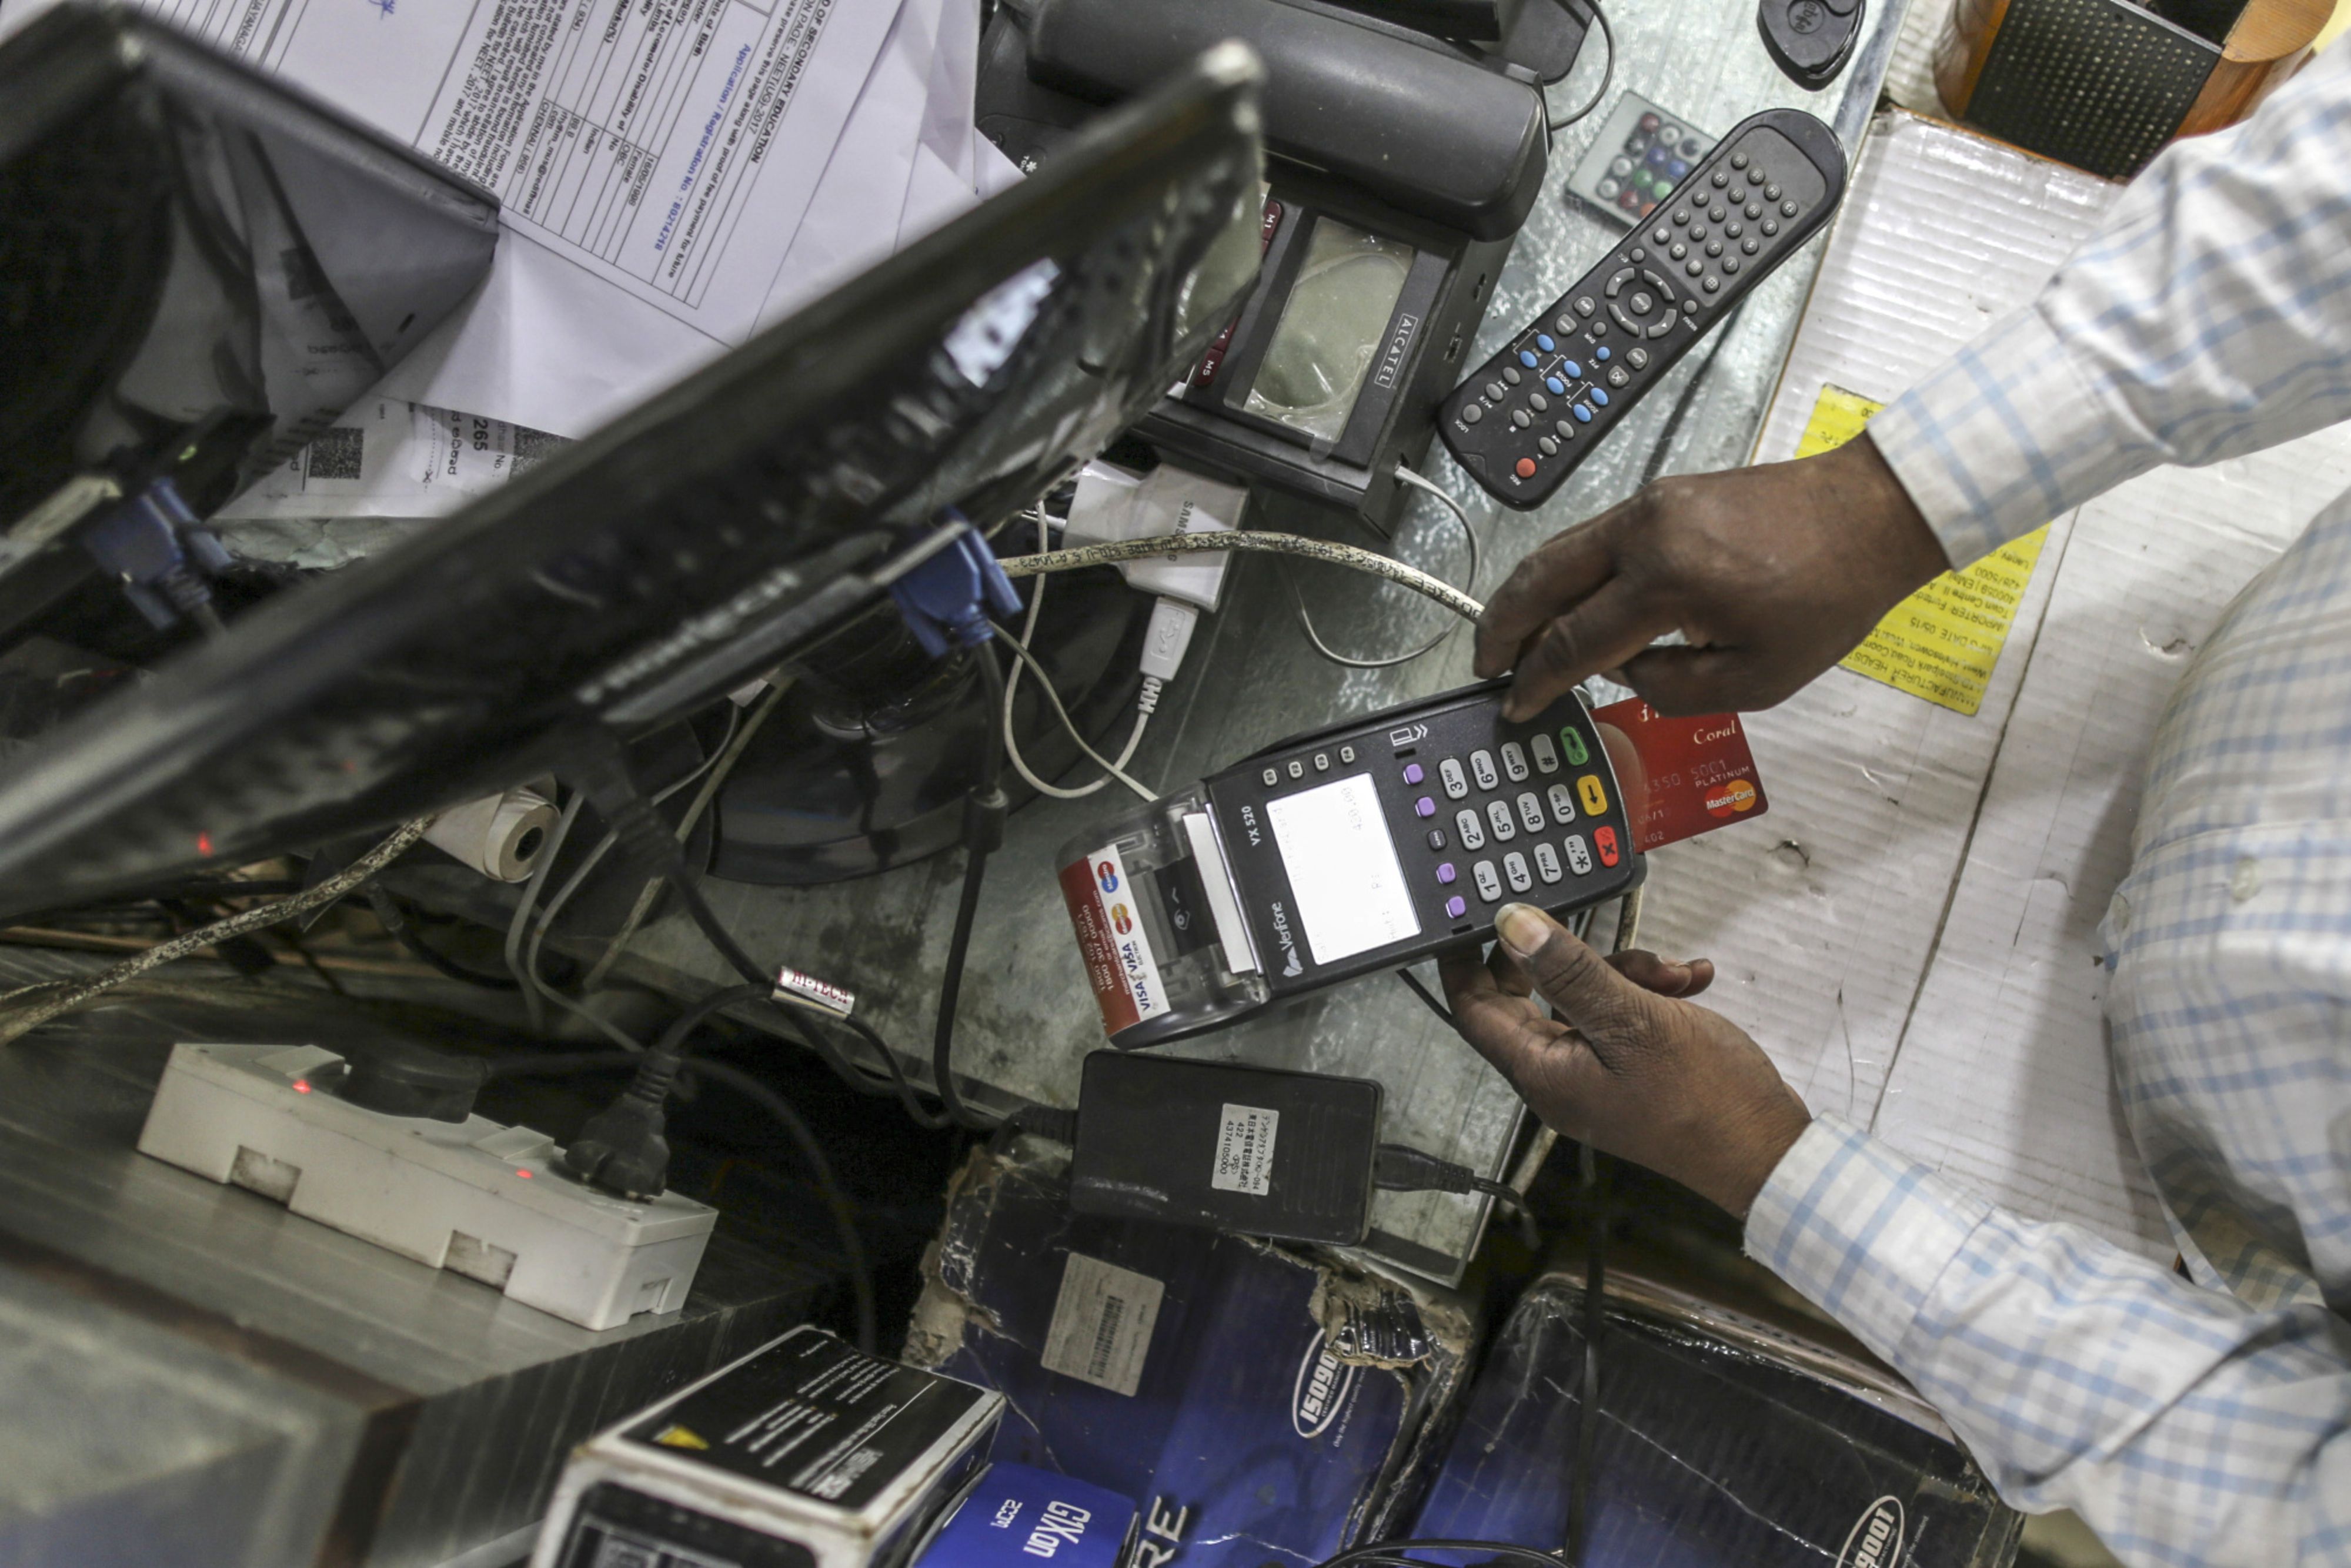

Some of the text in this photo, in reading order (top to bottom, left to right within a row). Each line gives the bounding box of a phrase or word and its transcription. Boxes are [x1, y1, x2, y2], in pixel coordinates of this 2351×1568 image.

[647, 2, 666, 33] Limbs
[692, 18, 715, 58] of Birth
[472, 6, 536, 146] which will result incancellation
[489, 22, 541, 133] furnished herein found
[616, 8, 675, 131] of Locomotor Disability of
[746, 13, 807, 135] PAGE NEET(UG)-2017
[442, 5, 517, 166] Bulletin 2017 which have
[477, 6, 557, 184] not concealed any information including
[750, 8, 826, 163] OF SECONDARY EDUCATION
[439, 73, 477, 146] 2017 and mobile
[464, 73, 499, 141] agree abide
[487, 12, 563, 189] stated by me in the Application Form are
[524, 101, 552, 147] CHENNAI
[582, 127, 599, 155] Indian
[607, 137, 619, 152] No
[615, 143, 631, 166] OBC
[653, 42, 752, 250] Application Registration 80214218
[667, 18, 789, 279] preserve this page along with proof of fee payment for future
[622, 149, 643, 183] Female
[1715, 172, 1725, 182] 12
[1752, 170, 1794, 213] 13 14 15
[1264, 213, 1275, 229] M1
[1694, 226, 1701, 235] 3
[1632, 295, 1649, 311] Enter
[1682, 315, 1698, 332] MENU
[1378, 316, 1412, 385] ALCATEL
[1583, 332, 1596, 345] DVR
[1201, 359, 1214, 377] M5
[1588, 357, 1600, 369] PTZ
[1554, 370, 1573, 388] FOCUS
[1582, 397, 1599, 414] ZOOM
[469, 417, 492, 452] 265
[1454, 419, 1469, 433] LOCK
[1508, 473, 1521, 486] REC
[1166, 499, 1194, 563] SAMSG
[1691, 718, 1738, 745] Coral
[1475, 757, 1494, 784] 6 MNO
[1506, 749, 1525, 775] 9 WXY
[1541, 755, 1555, 767] #
[1444, 767, 1463, 792] 3 DEF
[1694, 765, 1751, 788] PLATINUM
[1558, 805, 1572, 815] 0
[1705, 787, 1755, 810] MasterCard
[1241, 804, 1262, 846] VX 520
[1492, 810, 1511, 833] 5 JKL
[1522, 800, 1541, 825] 8 TUV
[1461, 817, 1480, 843] 2 ABC
[1101, 863, 1114, 890] Maestro
[1508, 860, 1527, 884] 4 GHI
[1539, 851, 1558, 876] 7 PRS
[1484, 883, 1497, 892] 1
[1081, 904, 1098, 939] 00000
[1267, 901, 1294, 950] VeriFone
[1094, 941, 1105, 962] 307
[1098, 928, 1113, 960] or email
[1121, 942, 1138, 972] VISA
[792, 971, 849, 1004] HI-TECH
[1100, 964, 1115, 991] 1800
[1136, 980, 1150, 1012] VISA
[1235, 1122, 1244, 1138] 422
[1219, 1120, 1234, 1175] 4374105000
[1341, 1402, 1355, 1424] highest
